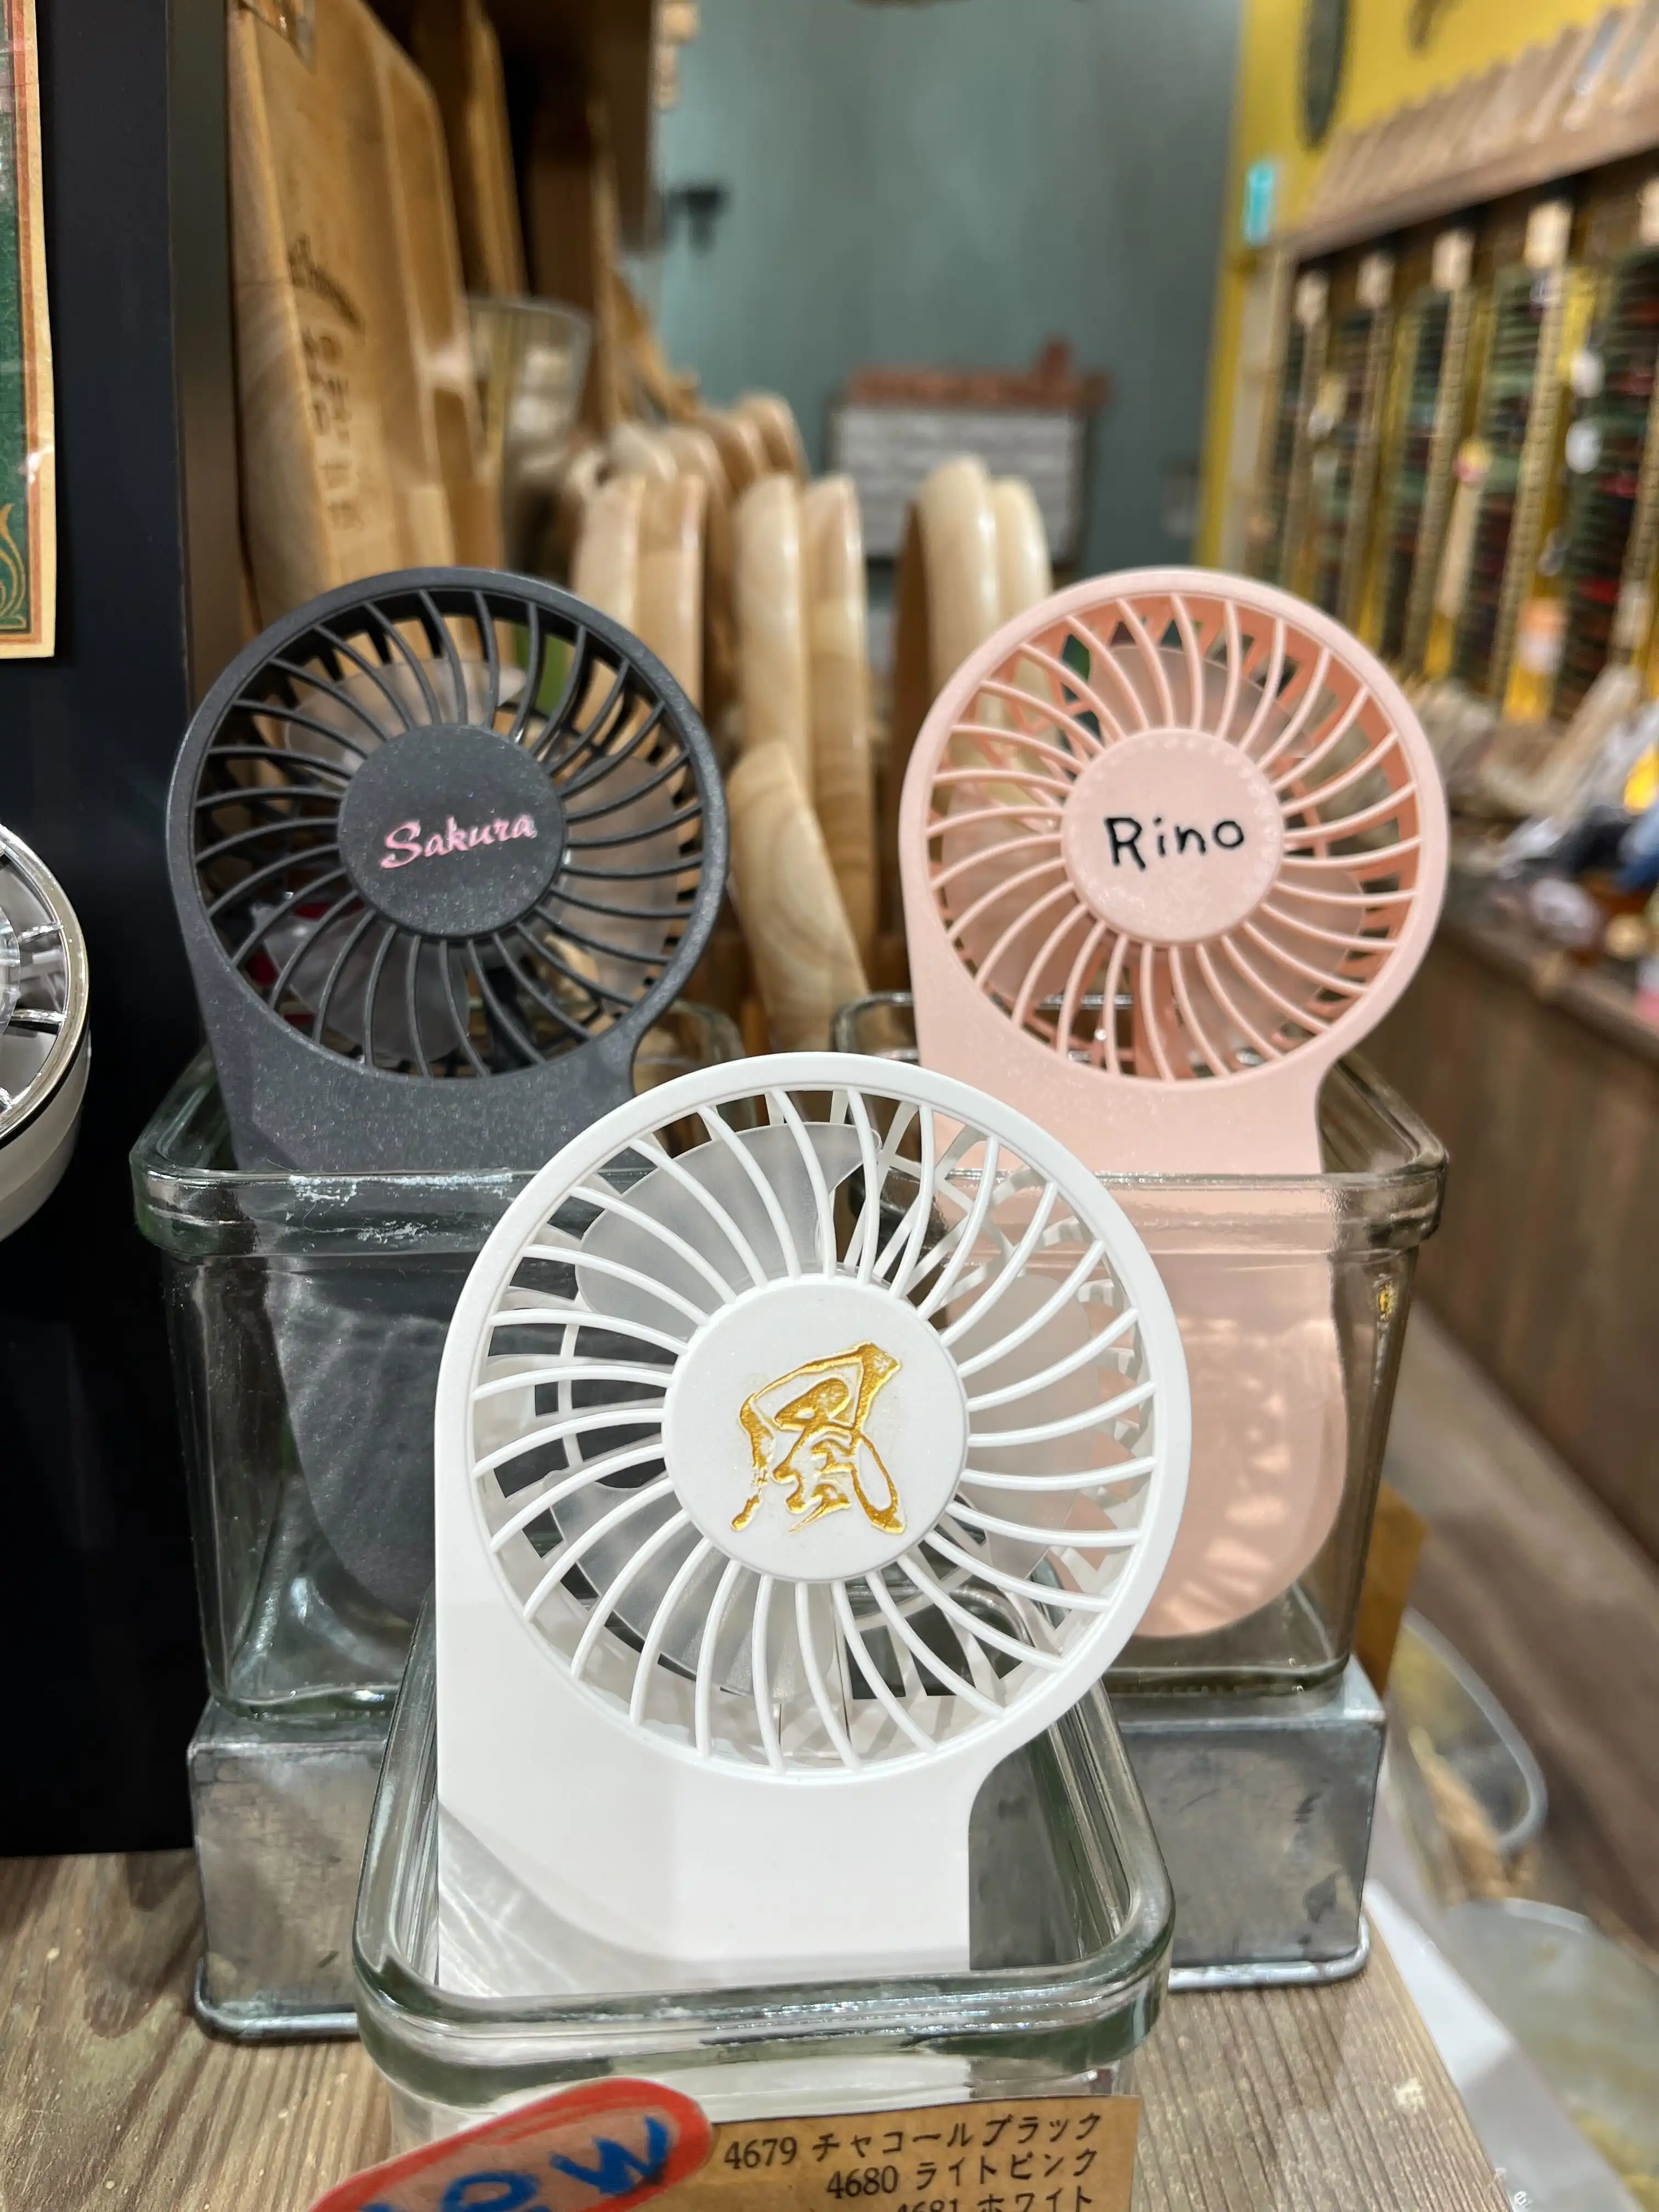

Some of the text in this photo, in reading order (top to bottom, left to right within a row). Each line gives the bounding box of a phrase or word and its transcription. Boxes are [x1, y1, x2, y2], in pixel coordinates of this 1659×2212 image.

[380, 813, 538, 868] Sakura
[1104, 816, 1244, 871] Rino
[724, 2112, 1101, 2170] 4679 チャコールブラック
[826, 2148, 1097, 2199] 4680 ライトピンク
